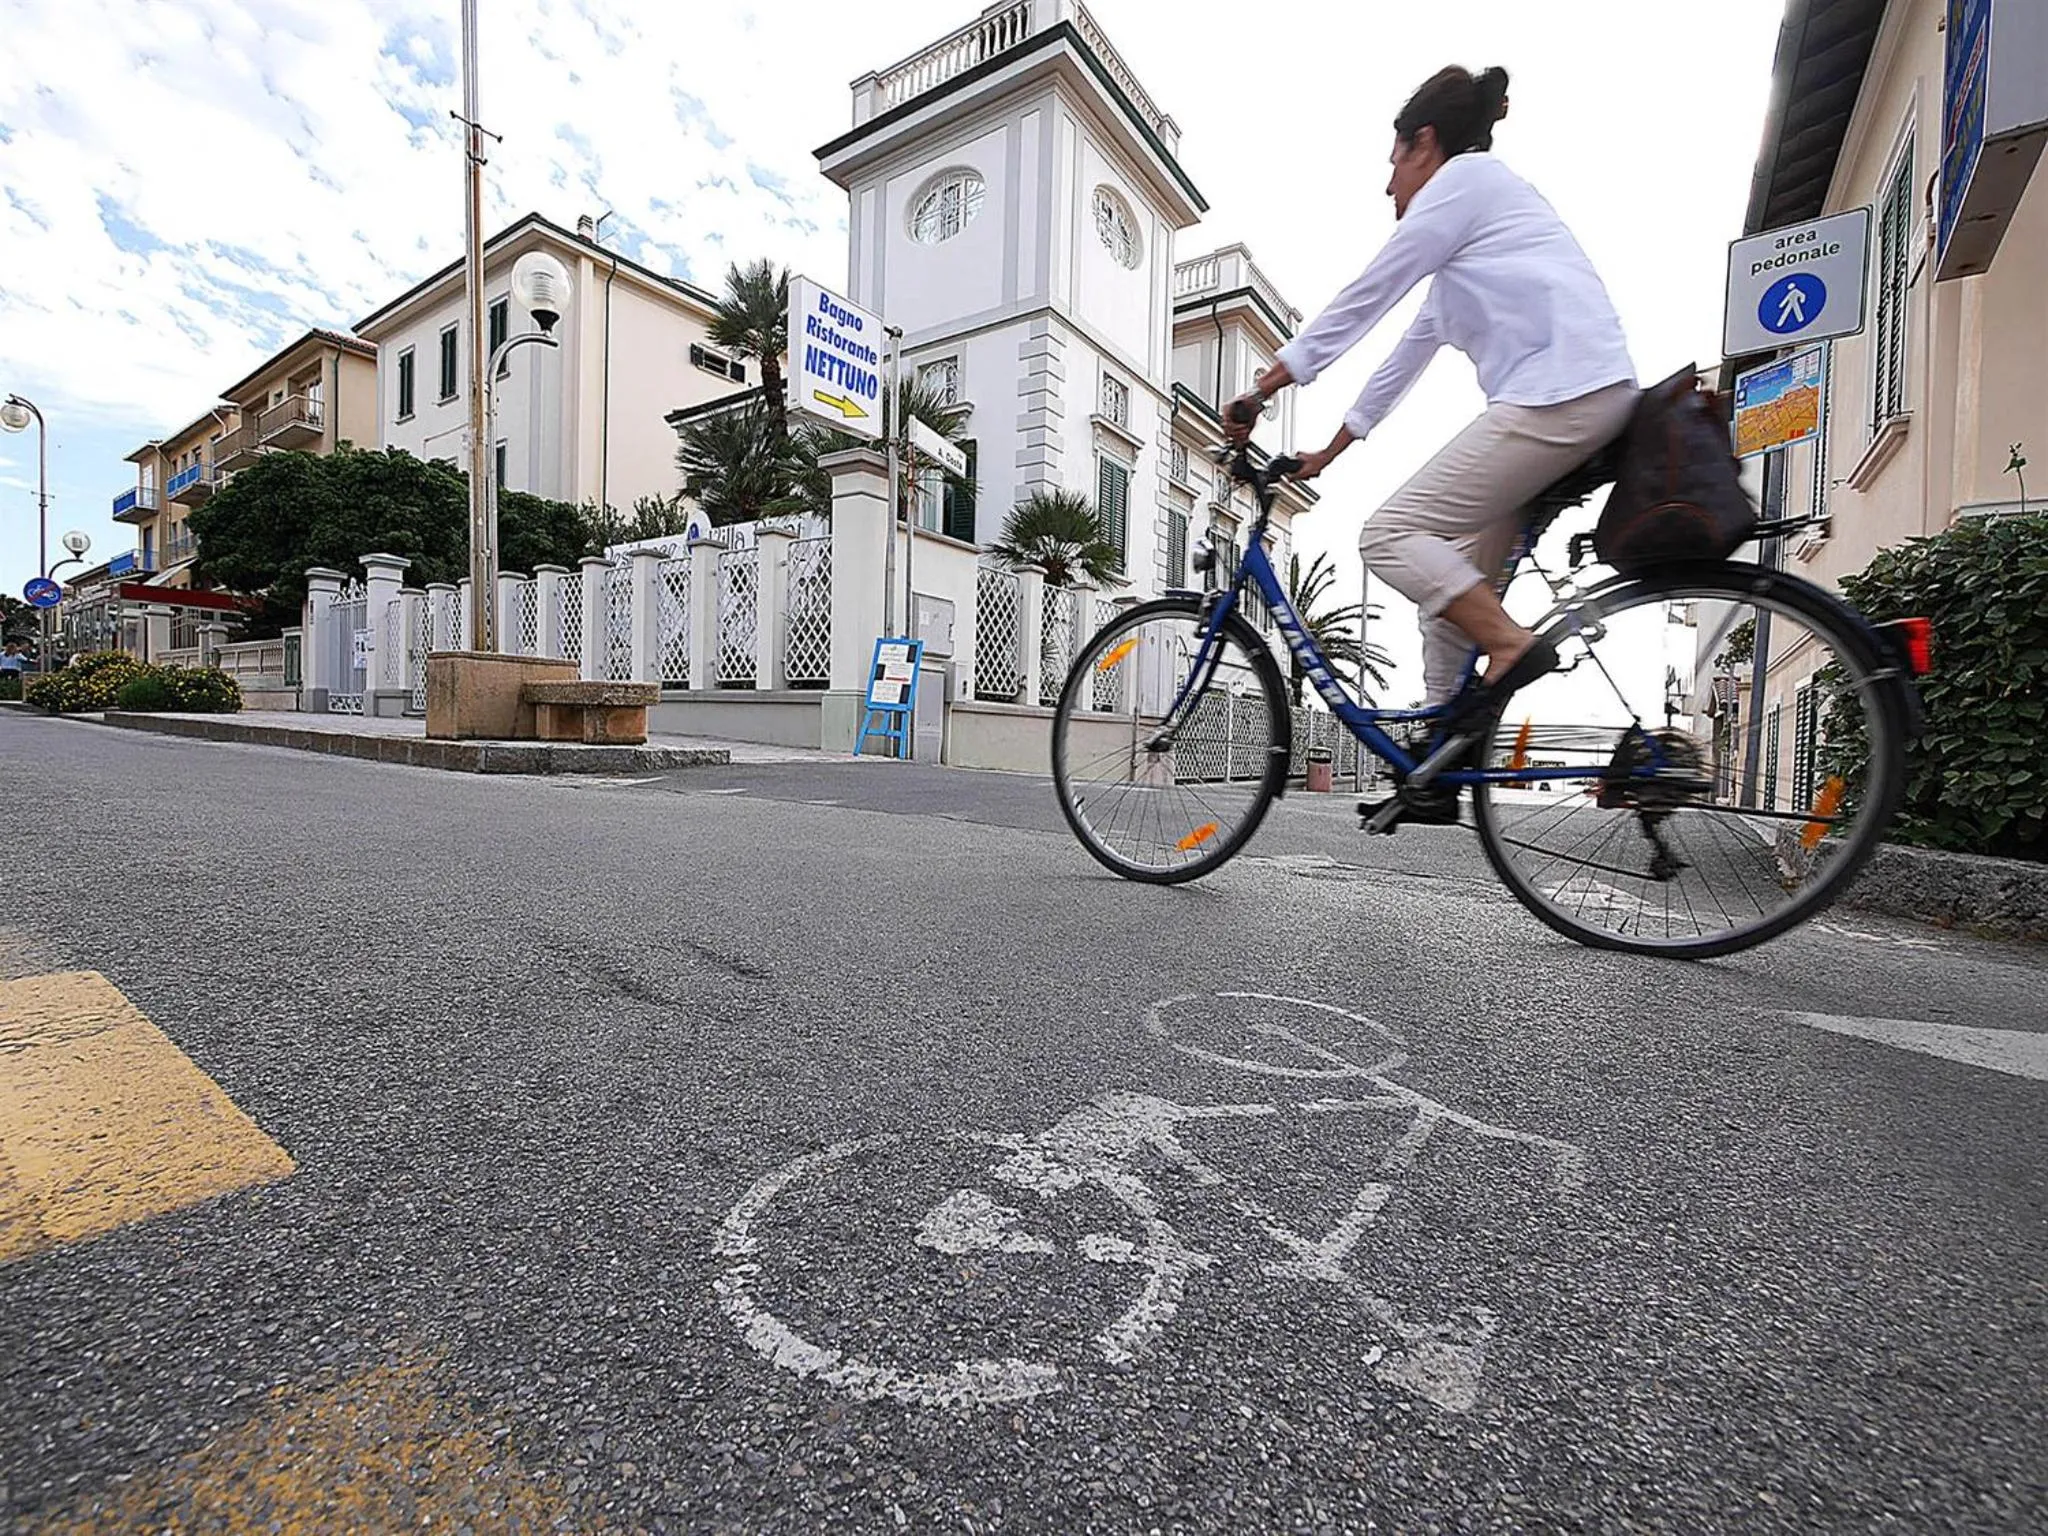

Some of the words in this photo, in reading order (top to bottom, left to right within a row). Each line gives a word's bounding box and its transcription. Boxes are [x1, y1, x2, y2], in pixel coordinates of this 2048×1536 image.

[1751, 241, 1840, 276] pedonale
[1774, 229, 1817, 249] area
[819, 292, 863, 332] Bagno
[806, 314, 877, 366] Ristorante
[805, 344, 878, 400] NETTUNO
